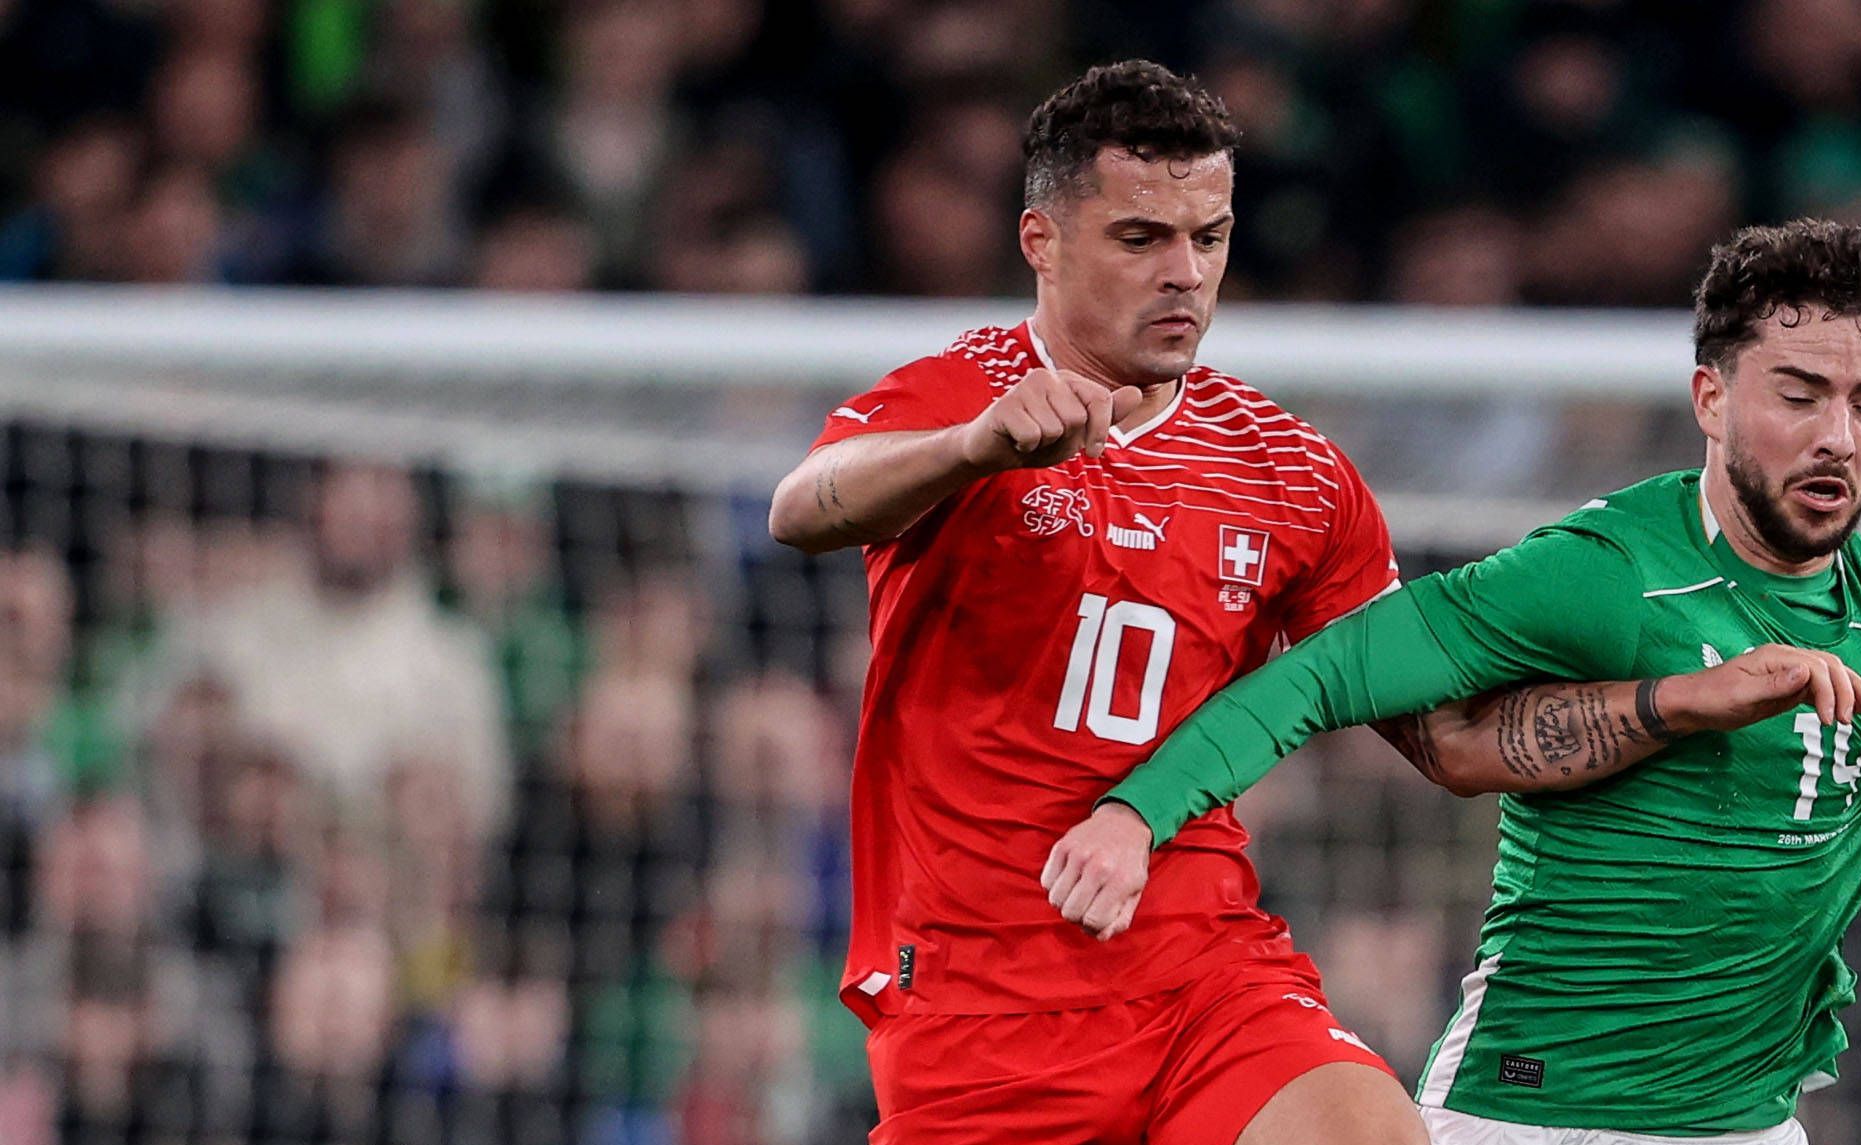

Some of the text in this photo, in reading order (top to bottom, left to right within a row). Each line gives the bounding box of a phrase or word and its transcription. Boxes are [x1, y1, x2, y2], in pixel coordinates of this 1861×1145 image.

[1106, 522, 1156, 550] PUMA
[1053, 592, 1177, 746] 10
[1777, 833, 1802, 846] 26th
